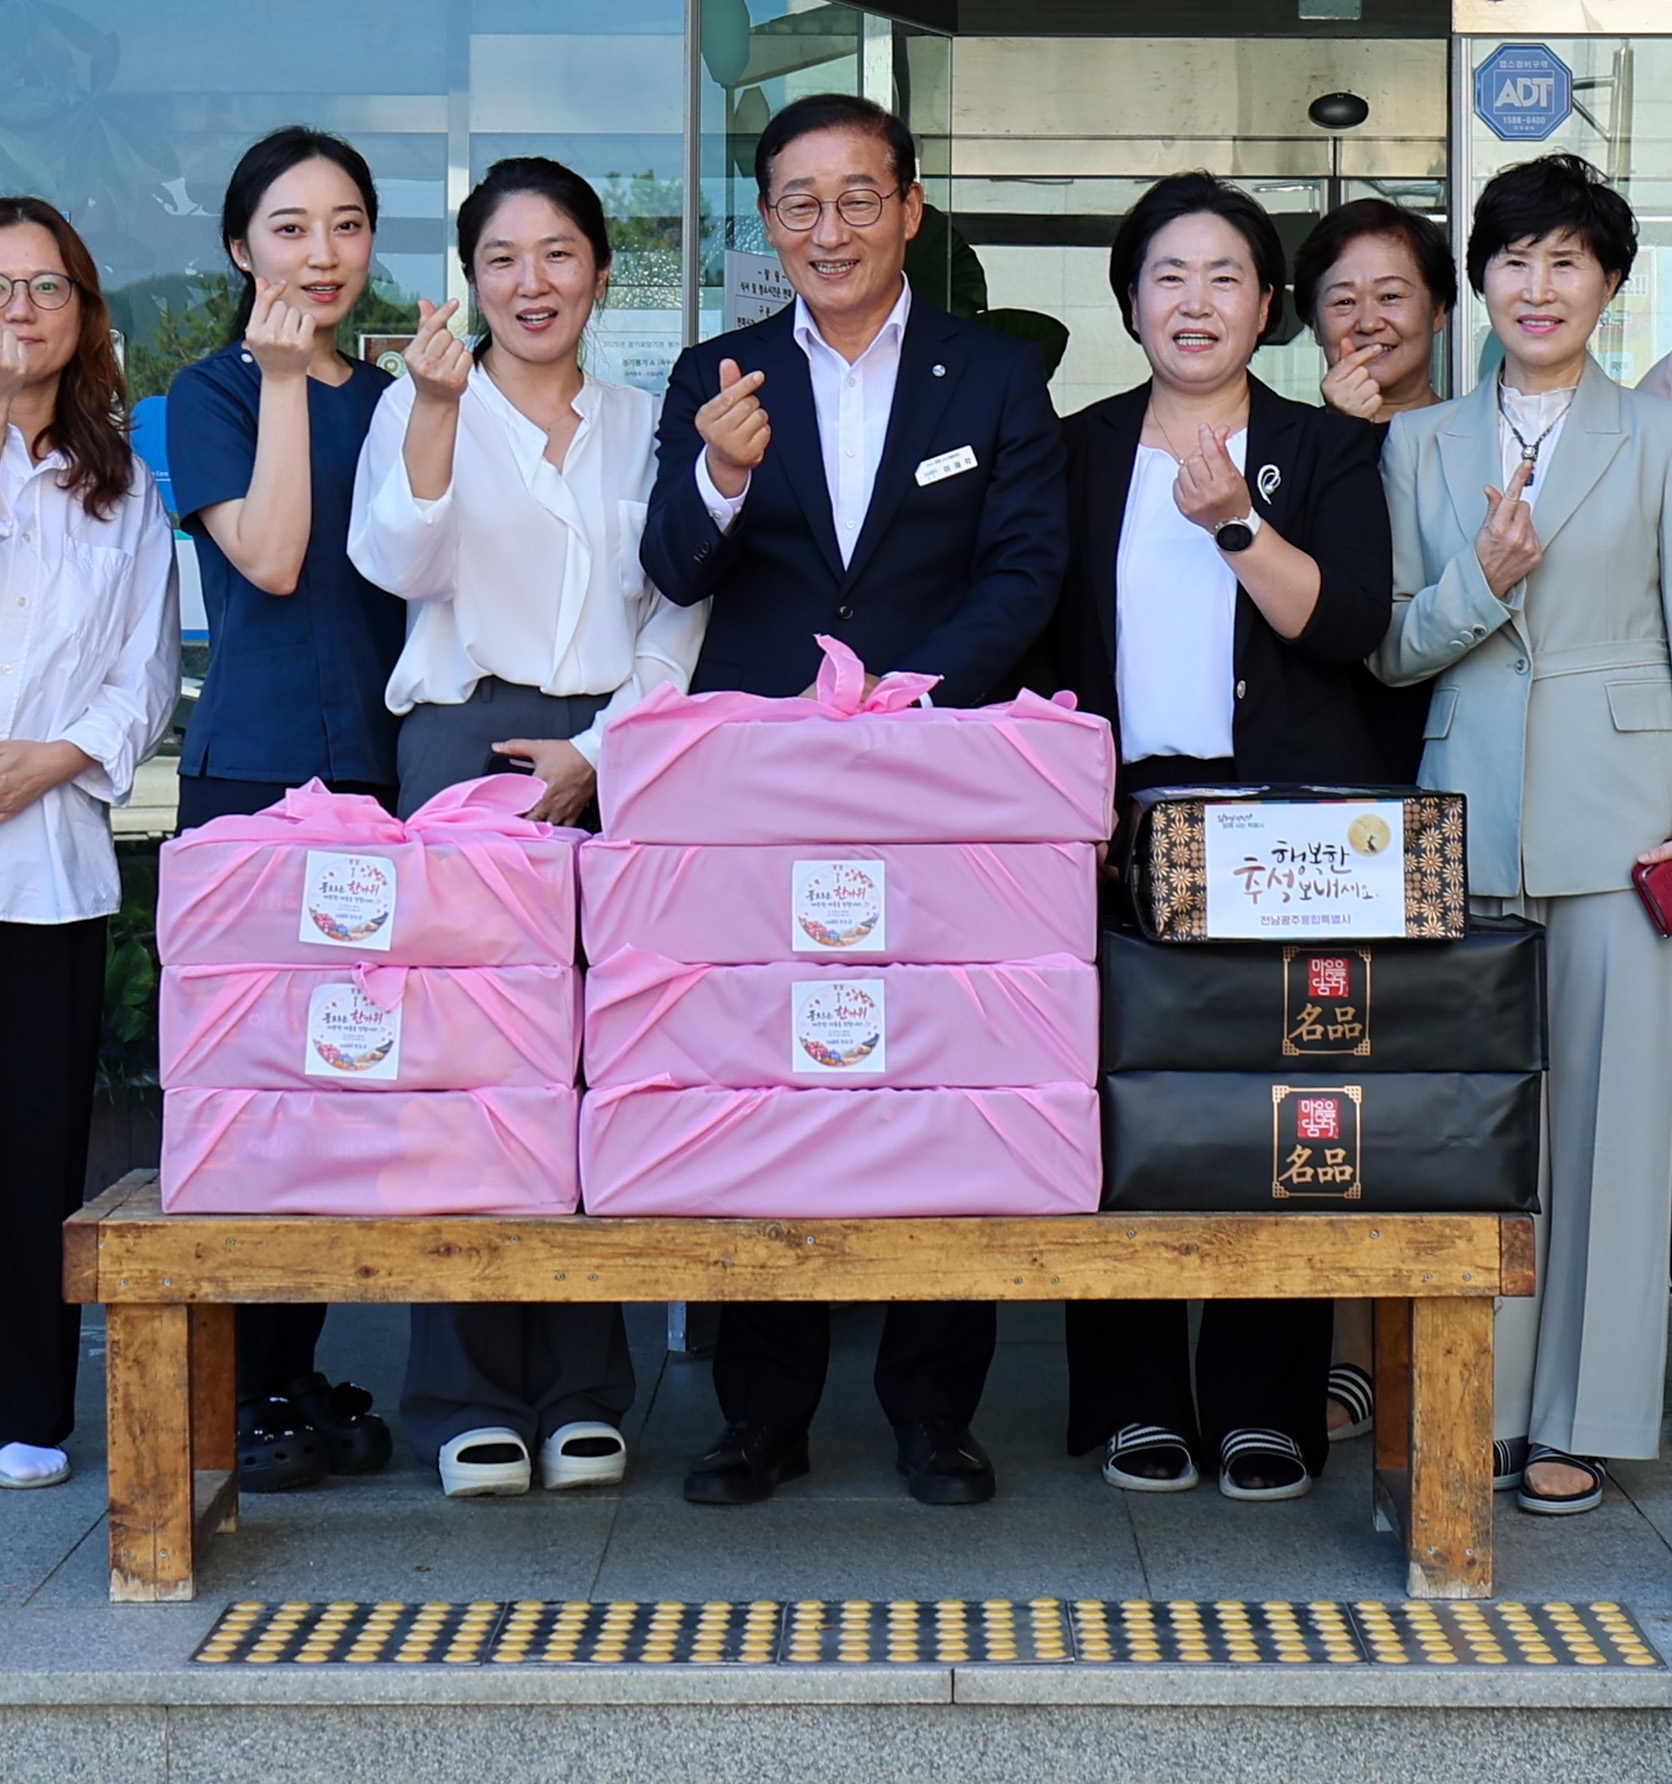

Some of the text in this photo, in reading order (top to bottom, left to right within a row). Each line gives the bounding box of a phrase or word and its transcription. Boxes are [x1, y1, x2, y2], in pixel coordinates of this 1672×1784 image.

[1494, 77, 1555, 108] ADT
[1503, 116, 1546, 124] 1588-6400
[1271, 840, 1352, 875] 행복한
[1232, 856, 1295, 905] 추석
[1288, 1002, 1364, 1042] 名品
[1277, 1144, 1354, 1184] 名品
